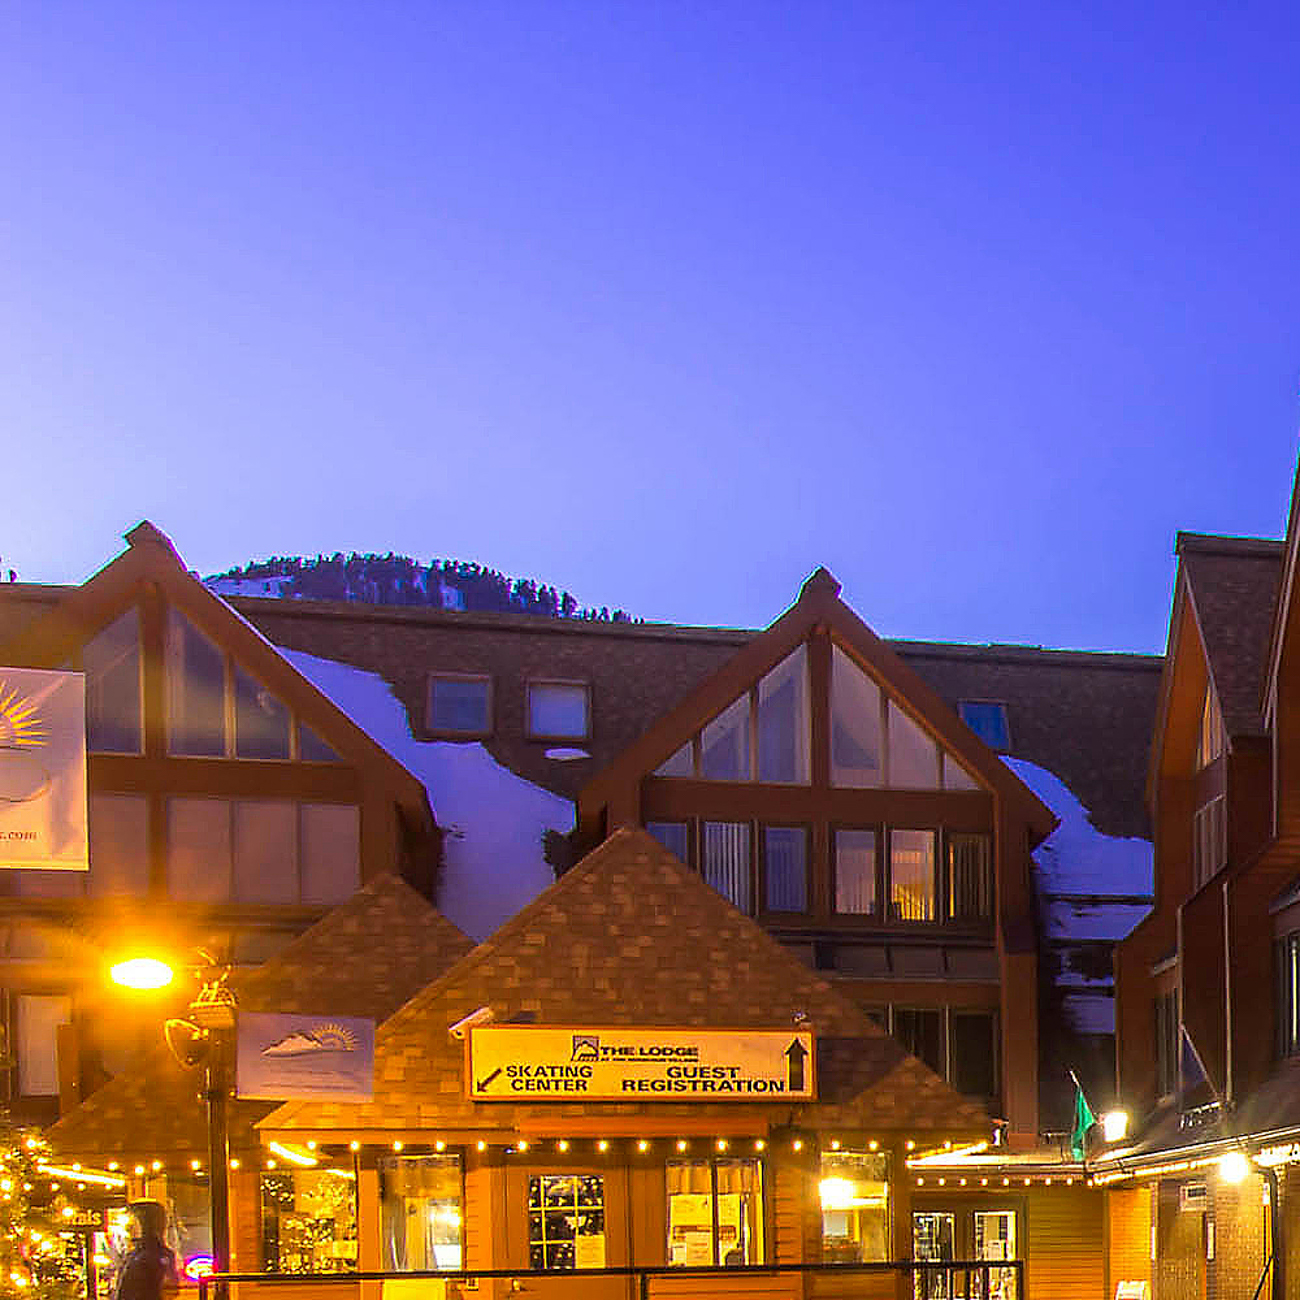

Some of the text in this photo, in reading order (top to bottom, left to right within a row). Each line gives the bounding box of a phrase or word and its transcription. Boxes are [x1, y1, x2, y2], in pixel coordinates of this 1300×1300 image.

[600, 1046, 699, 1057] THE LODGE
[506, 1065, 742, 1080] SKATING GUEST
[510, 1078, 785, 1094] CENTER REGISTRATION
